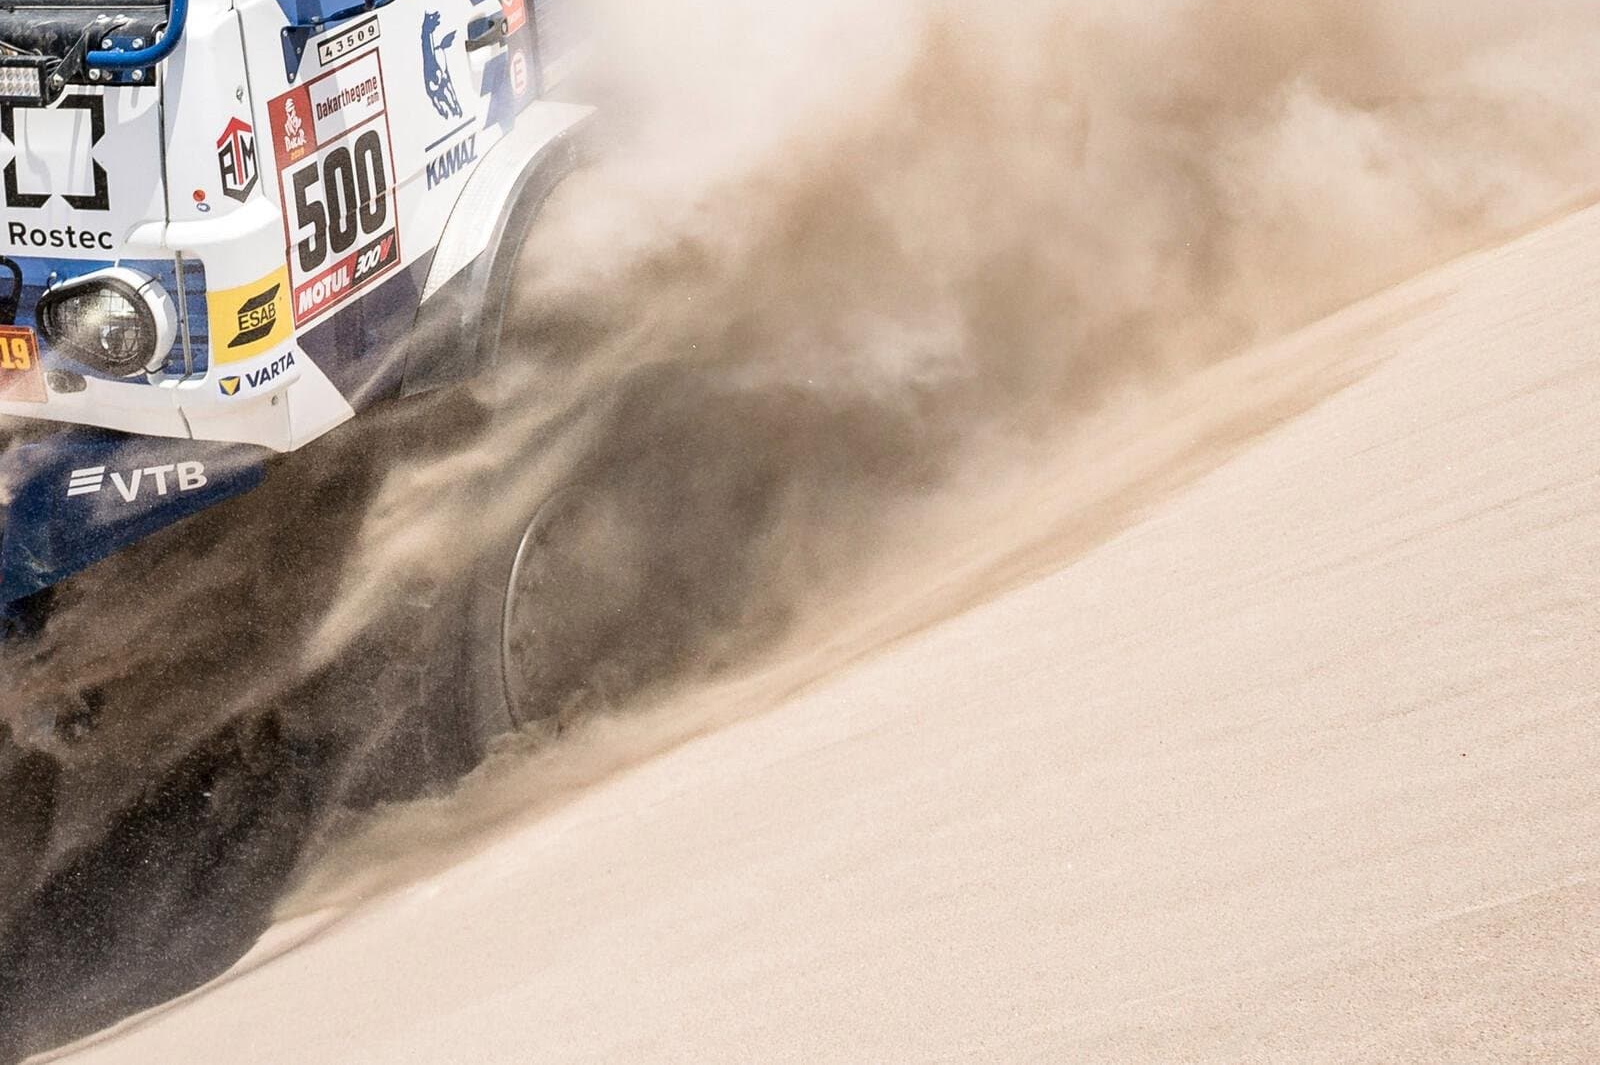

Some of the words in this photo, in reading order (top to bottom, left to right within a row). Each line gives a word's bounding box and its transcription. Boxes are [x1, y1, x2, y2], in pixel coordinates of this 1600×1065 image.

[325, 24, 376, 58] 43509
[316, 76, 379, 122] Dakarthegame
[426, 132, 478, 191] KAMAZ
[292, 129, 387, 273] 500
[8, 221, 113, 251] Rostec
[298, 264, 351, 316] MOTUL
[237, 302, 277, 331] ESAB
[245, 351, 296, 389] VARTA
[109, 460, 208, 503] VTB
